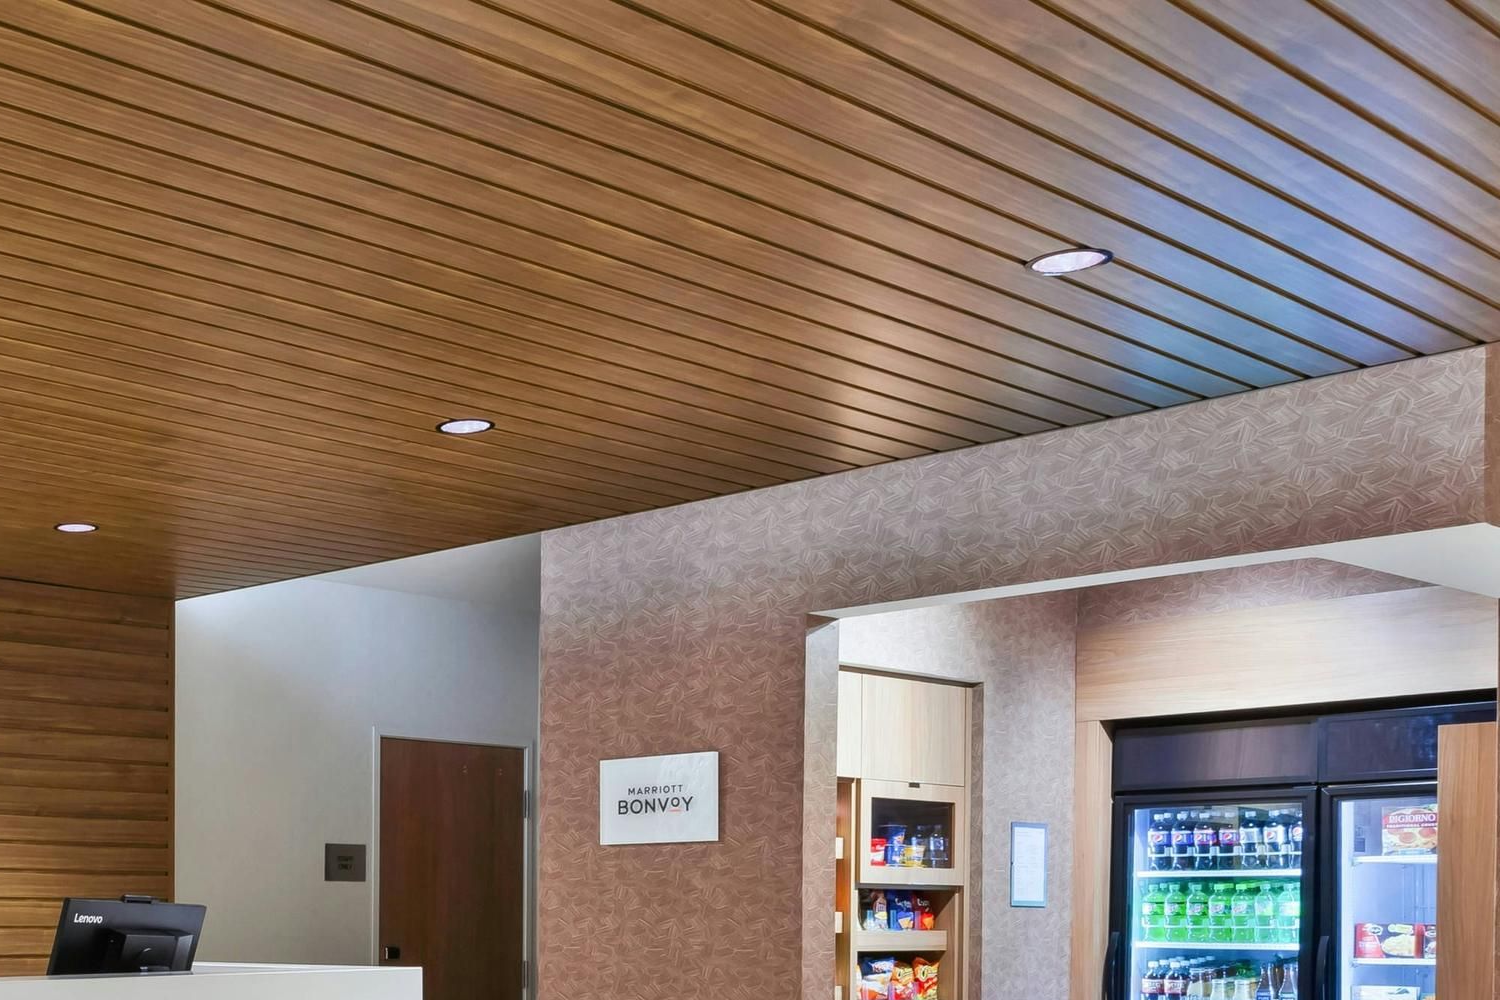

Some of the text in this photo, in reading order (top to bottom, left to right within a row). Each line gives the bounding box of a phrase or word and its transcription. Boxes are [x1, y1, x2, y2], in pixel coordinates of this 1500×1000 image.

[628, 785, 683, 795] MARRIOTT
[618, 796, 693, 815] BONVOY
[74, 913, 103, 923] Lenovo
